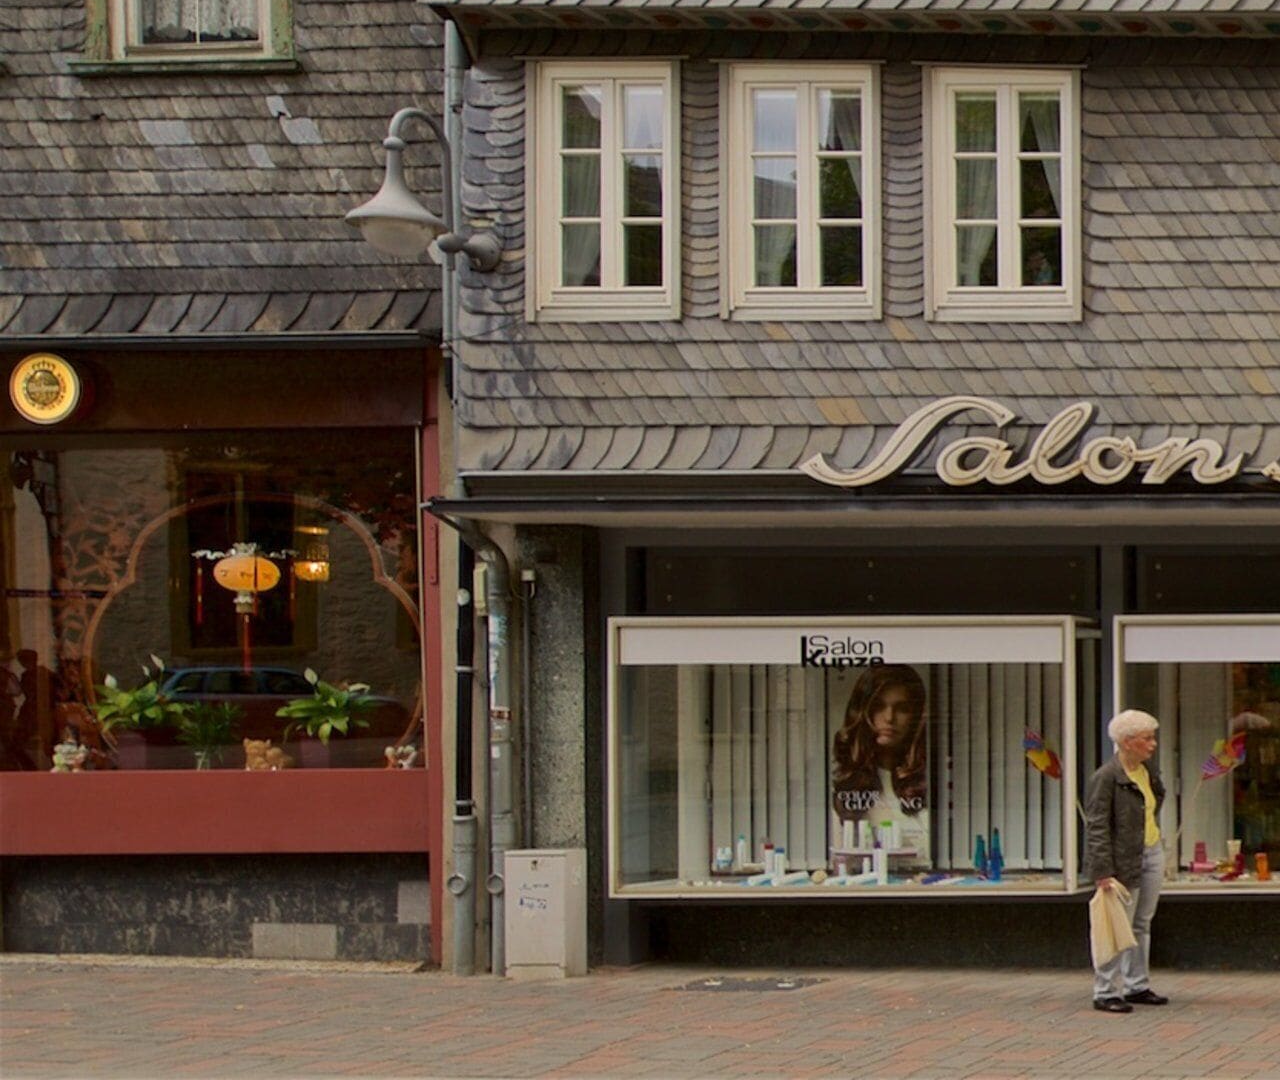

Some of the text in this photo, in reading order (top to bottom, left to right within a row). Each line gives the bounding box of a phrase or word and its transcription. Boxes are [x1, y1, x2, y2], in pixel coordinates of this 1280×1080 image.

[799, 395, 1245, 488] Salon
[800, 636, 885, 668] Kunze
[808, 634, 885, 655] Salon
[837, 790, 881, 802] COLOR
